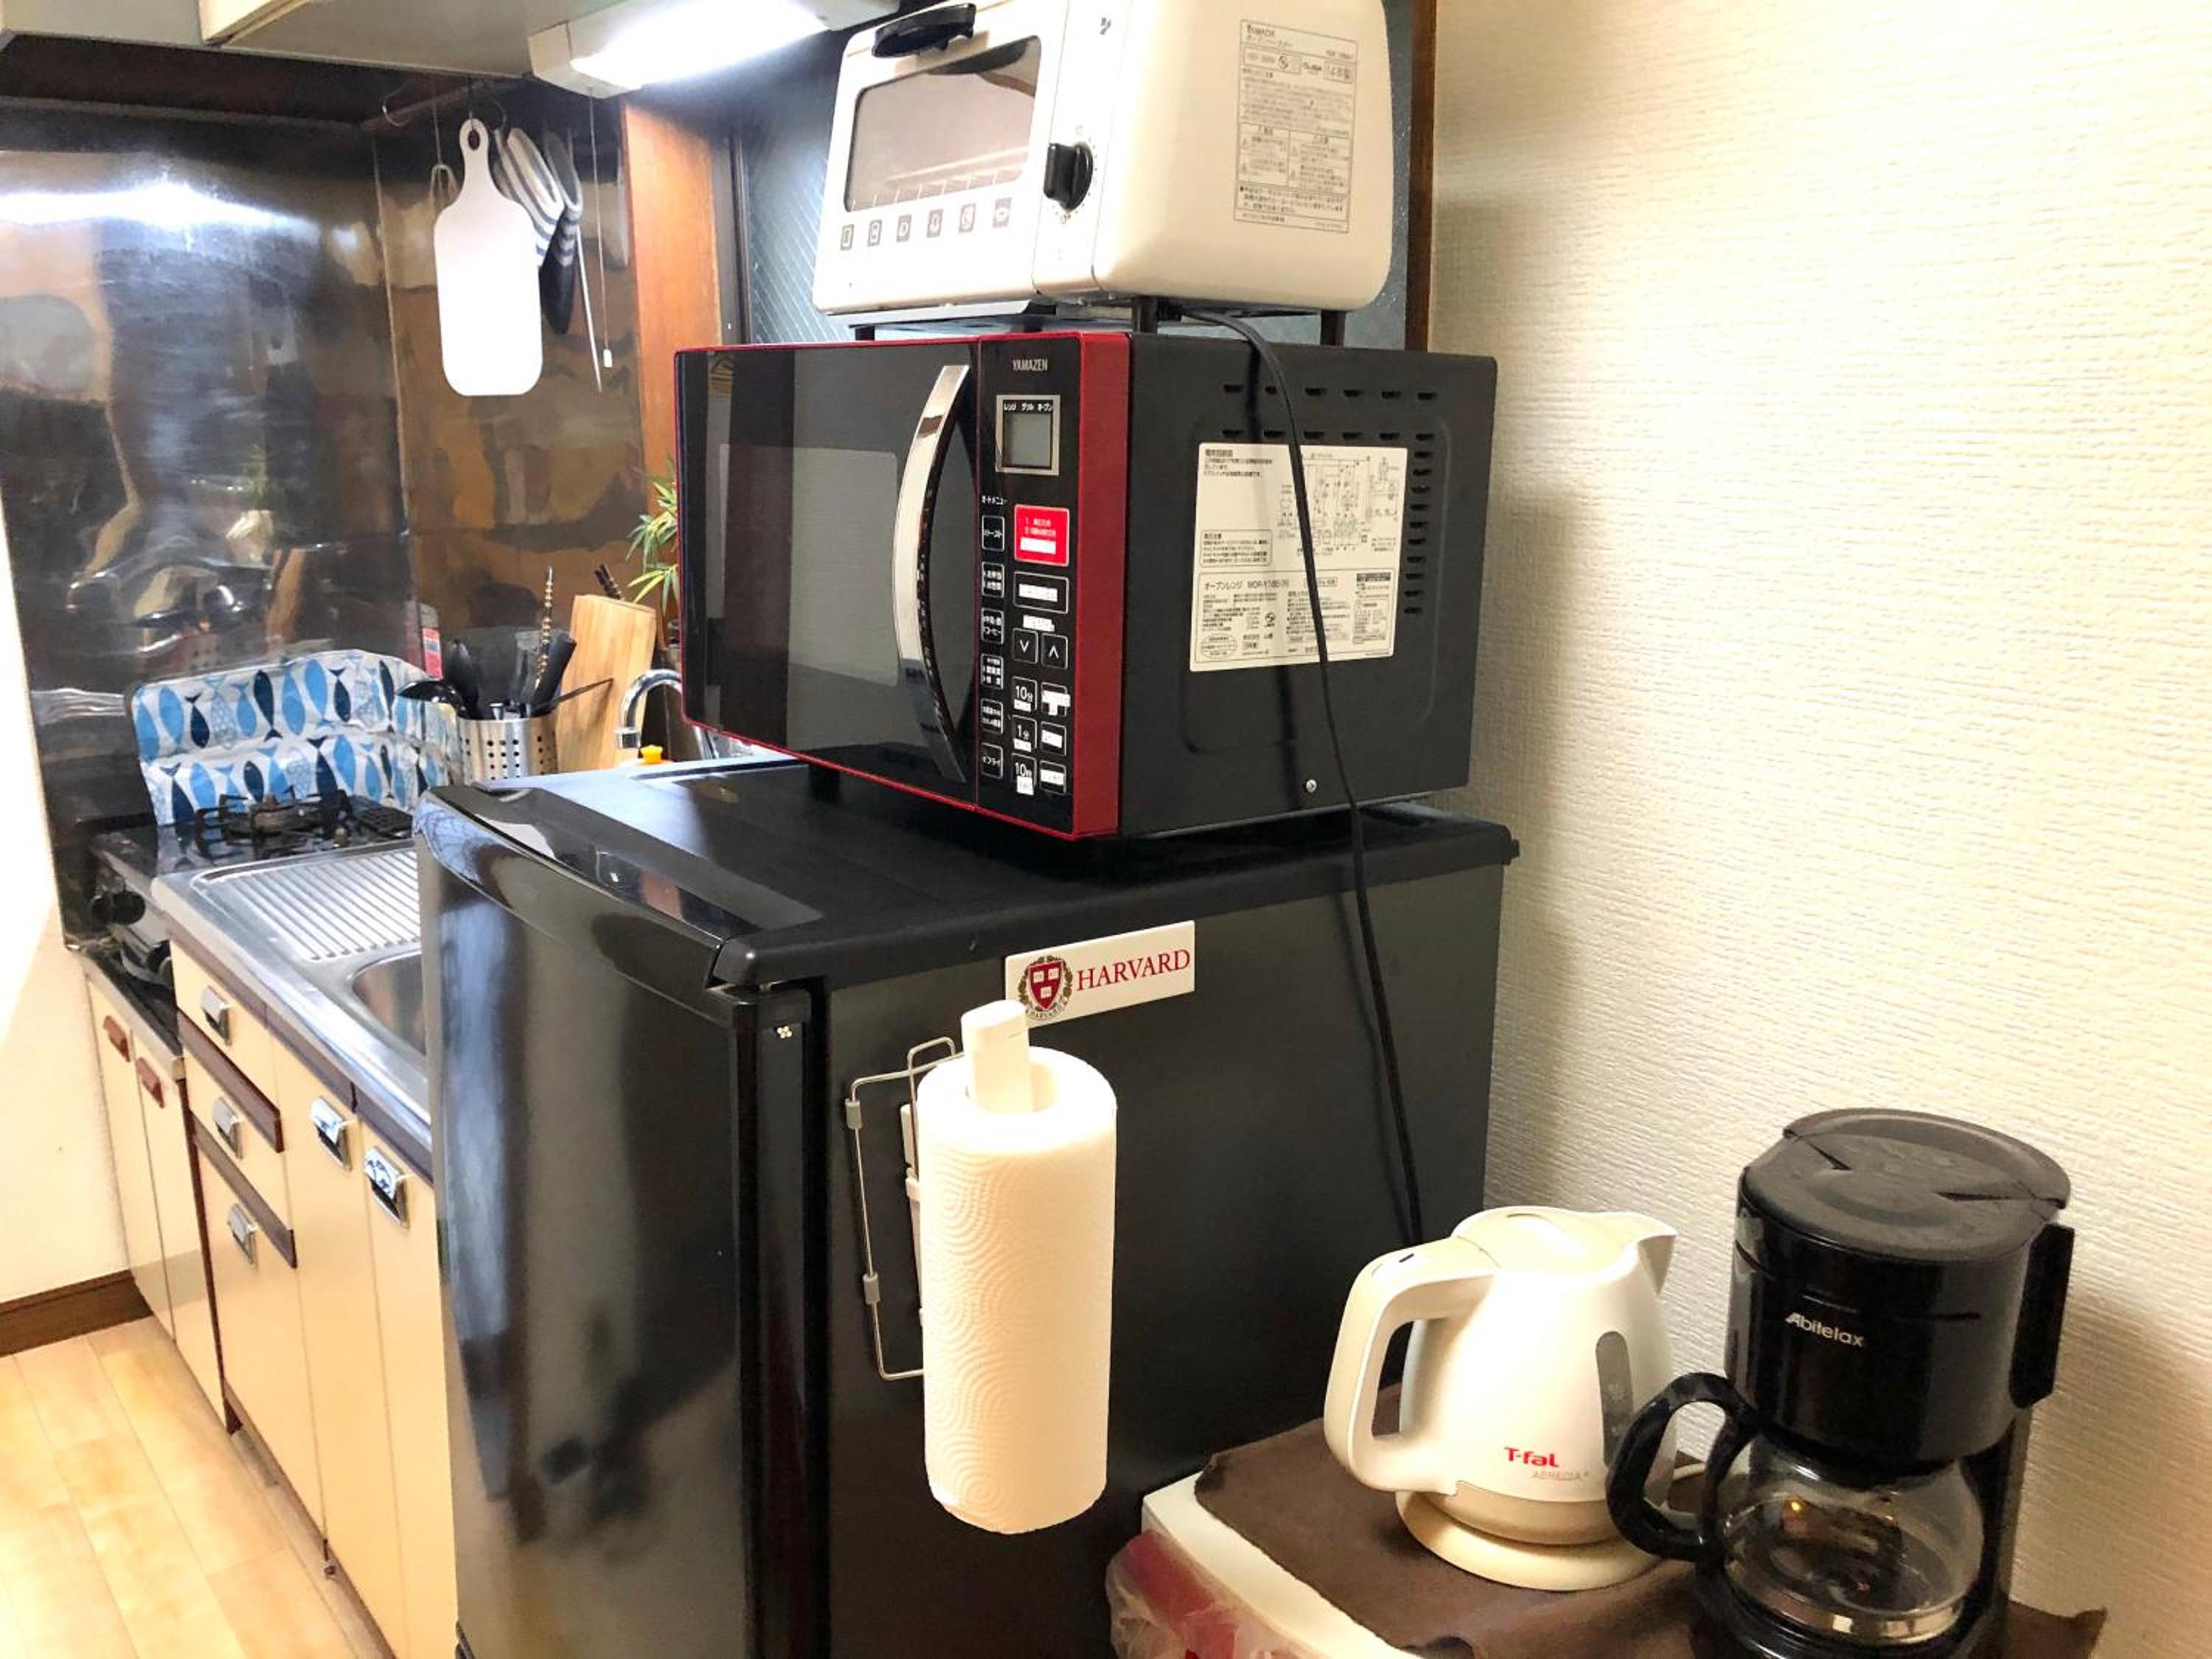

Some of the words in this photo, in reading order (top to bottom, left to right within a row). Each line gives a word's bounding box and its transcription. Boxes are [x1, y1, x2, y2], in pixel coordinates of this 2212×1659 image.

[1012, 358, 1048, 372] YAMAZEN
[1077, 948, 1191, 991] HARVARD
[1784, 1312, 1865, 1348] Abitelax
[1504, 1446, 1559, 1467] T-fal
